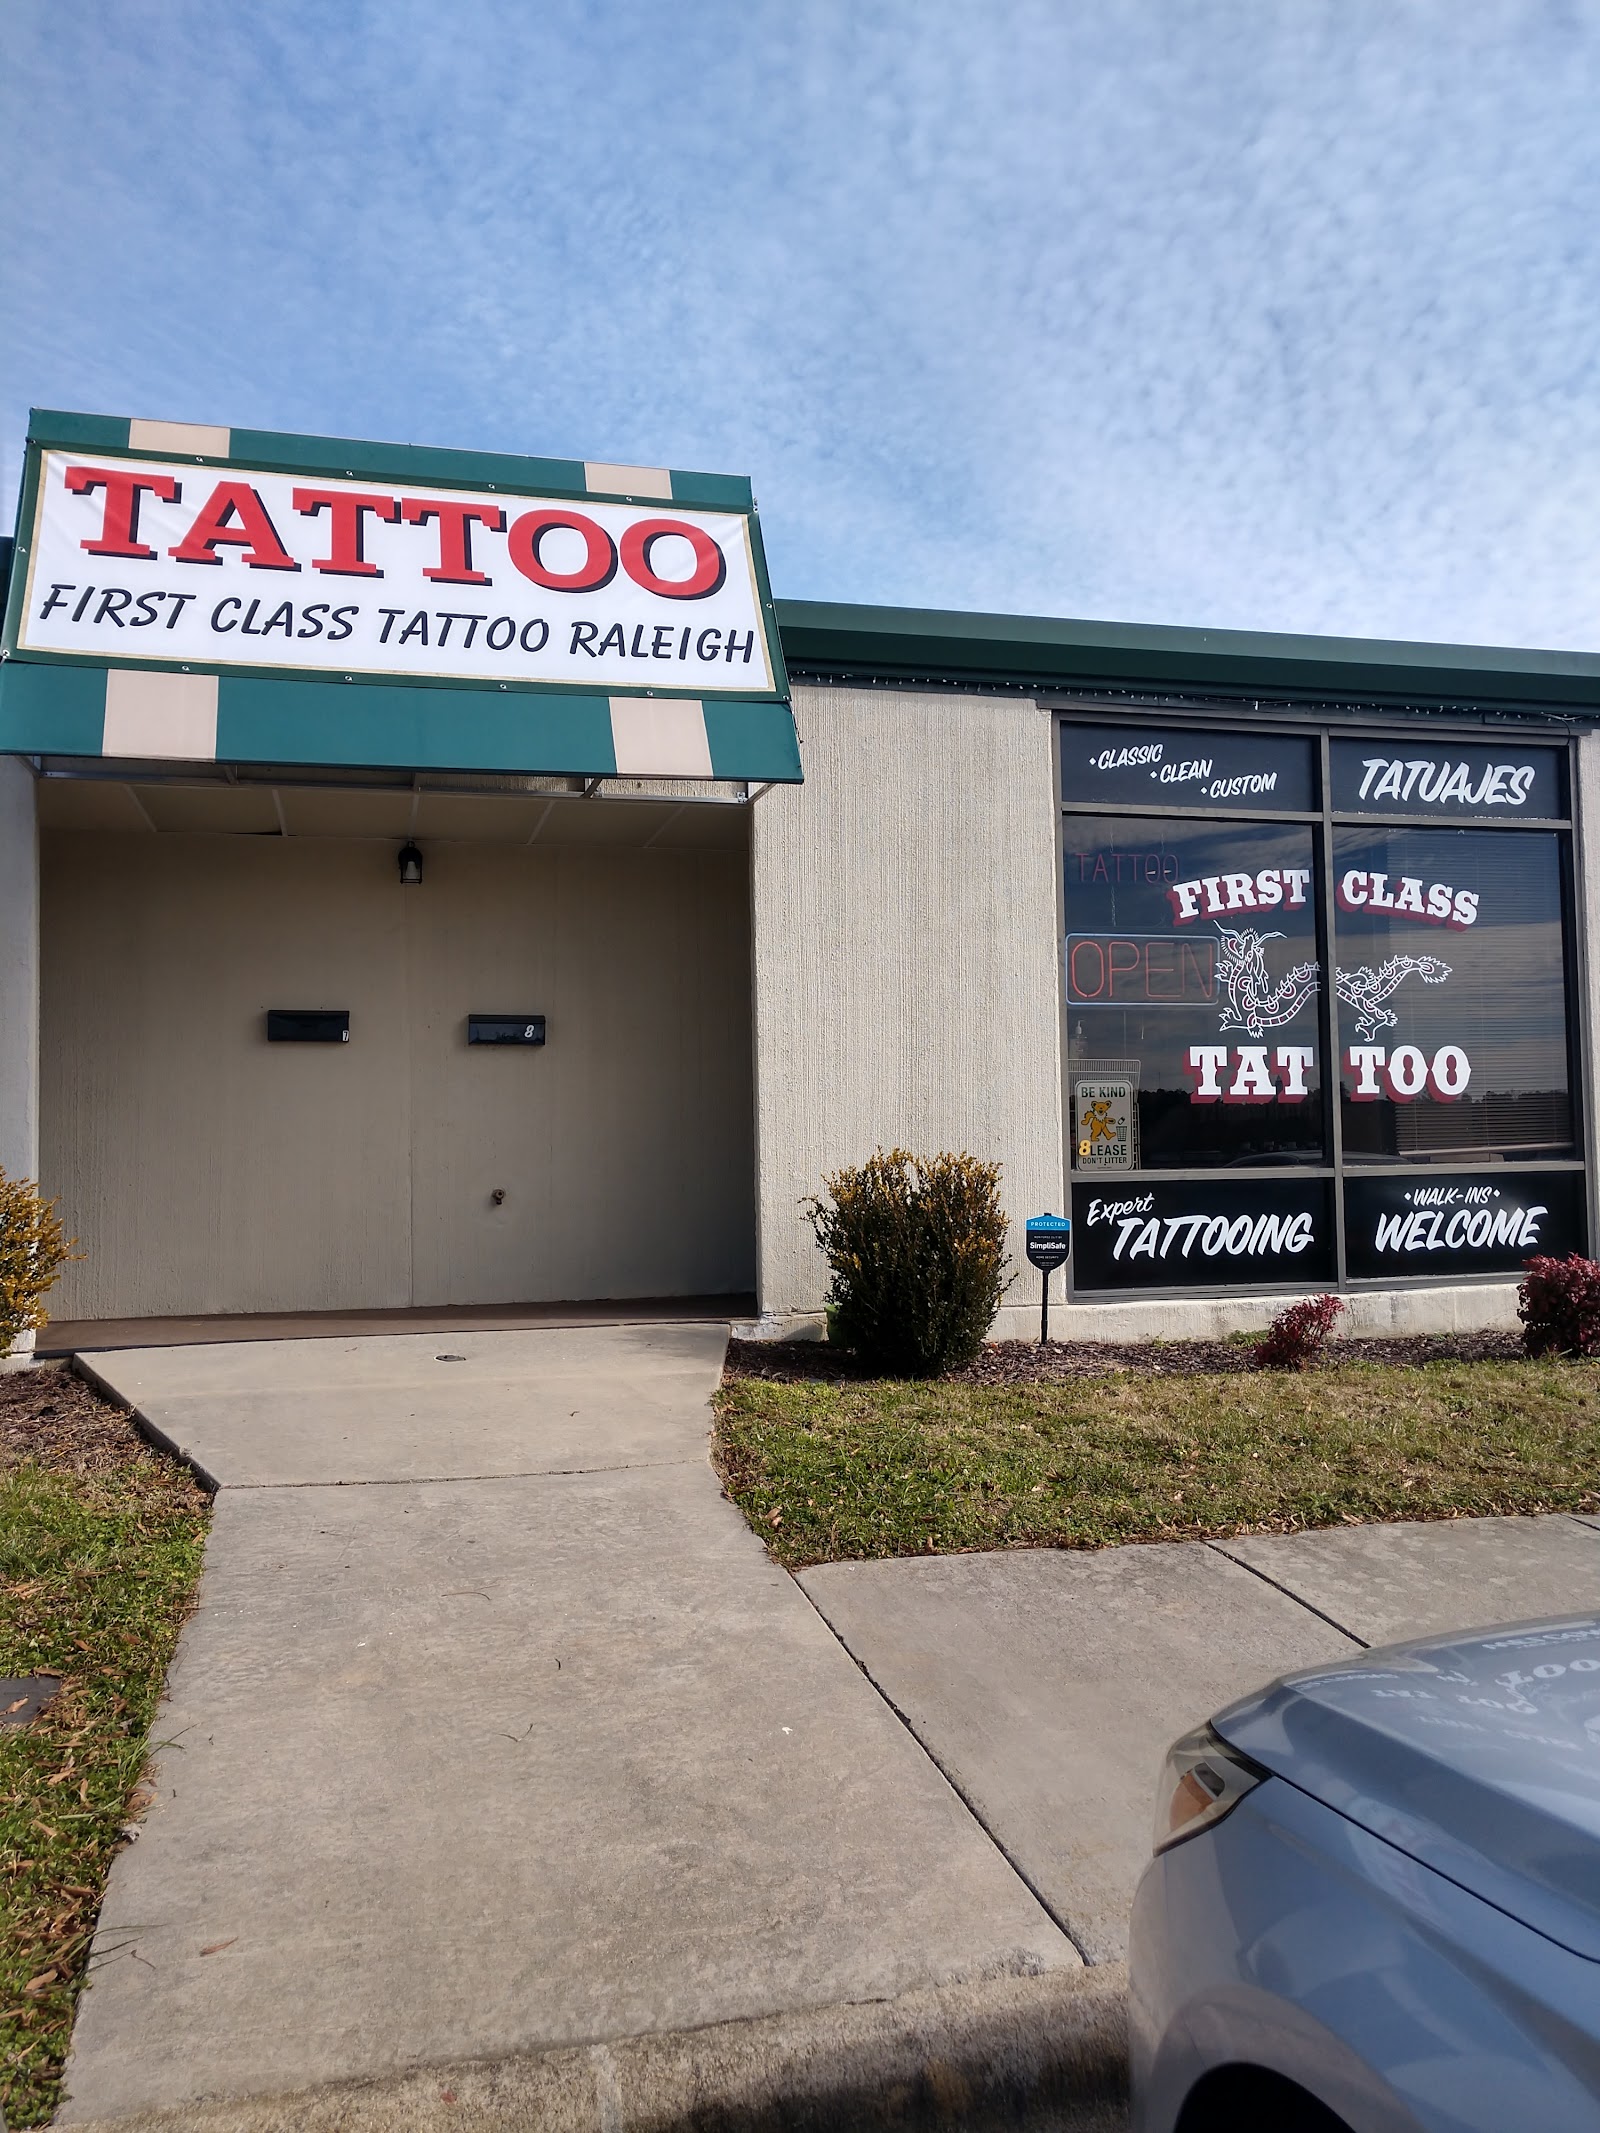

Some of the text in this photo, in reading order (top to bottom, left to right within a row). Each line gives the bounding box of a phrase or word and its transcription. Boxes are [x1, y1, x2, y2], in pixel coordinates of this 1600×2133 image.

[64, 465, 727, 600] TATTOO
[40, 584, 753, 664] FIRST CLASS TATTOO RALEIGH
[1098, 744, 1163, 771] CLASSIC
[1159, 759, 1213, 784] CLEAN
[1209, 772, 1277, 799] CUSTOM
[1358, 758, 1536, 805] TATUAJES
[1074, 853, 1180, 885] TATTOO
[1166, 869, 1480, 931] FIRST CLASS
[1071, 940, 1216, 999] OPEN
[524, 1025, 534, 1038] 8
[1081, 1087, 1126, 1098] BE KIND
[1087, 1192, 1155, 1226] Expert
[1413, 1187, 1493, 1207] WALK-INS
[1030, 1242, 1066, 1250] SimpliSafe
[1112, 1212, 1314, 1261] TATTOOING
[1375, 1206, 1548, 1253] WELCOME
